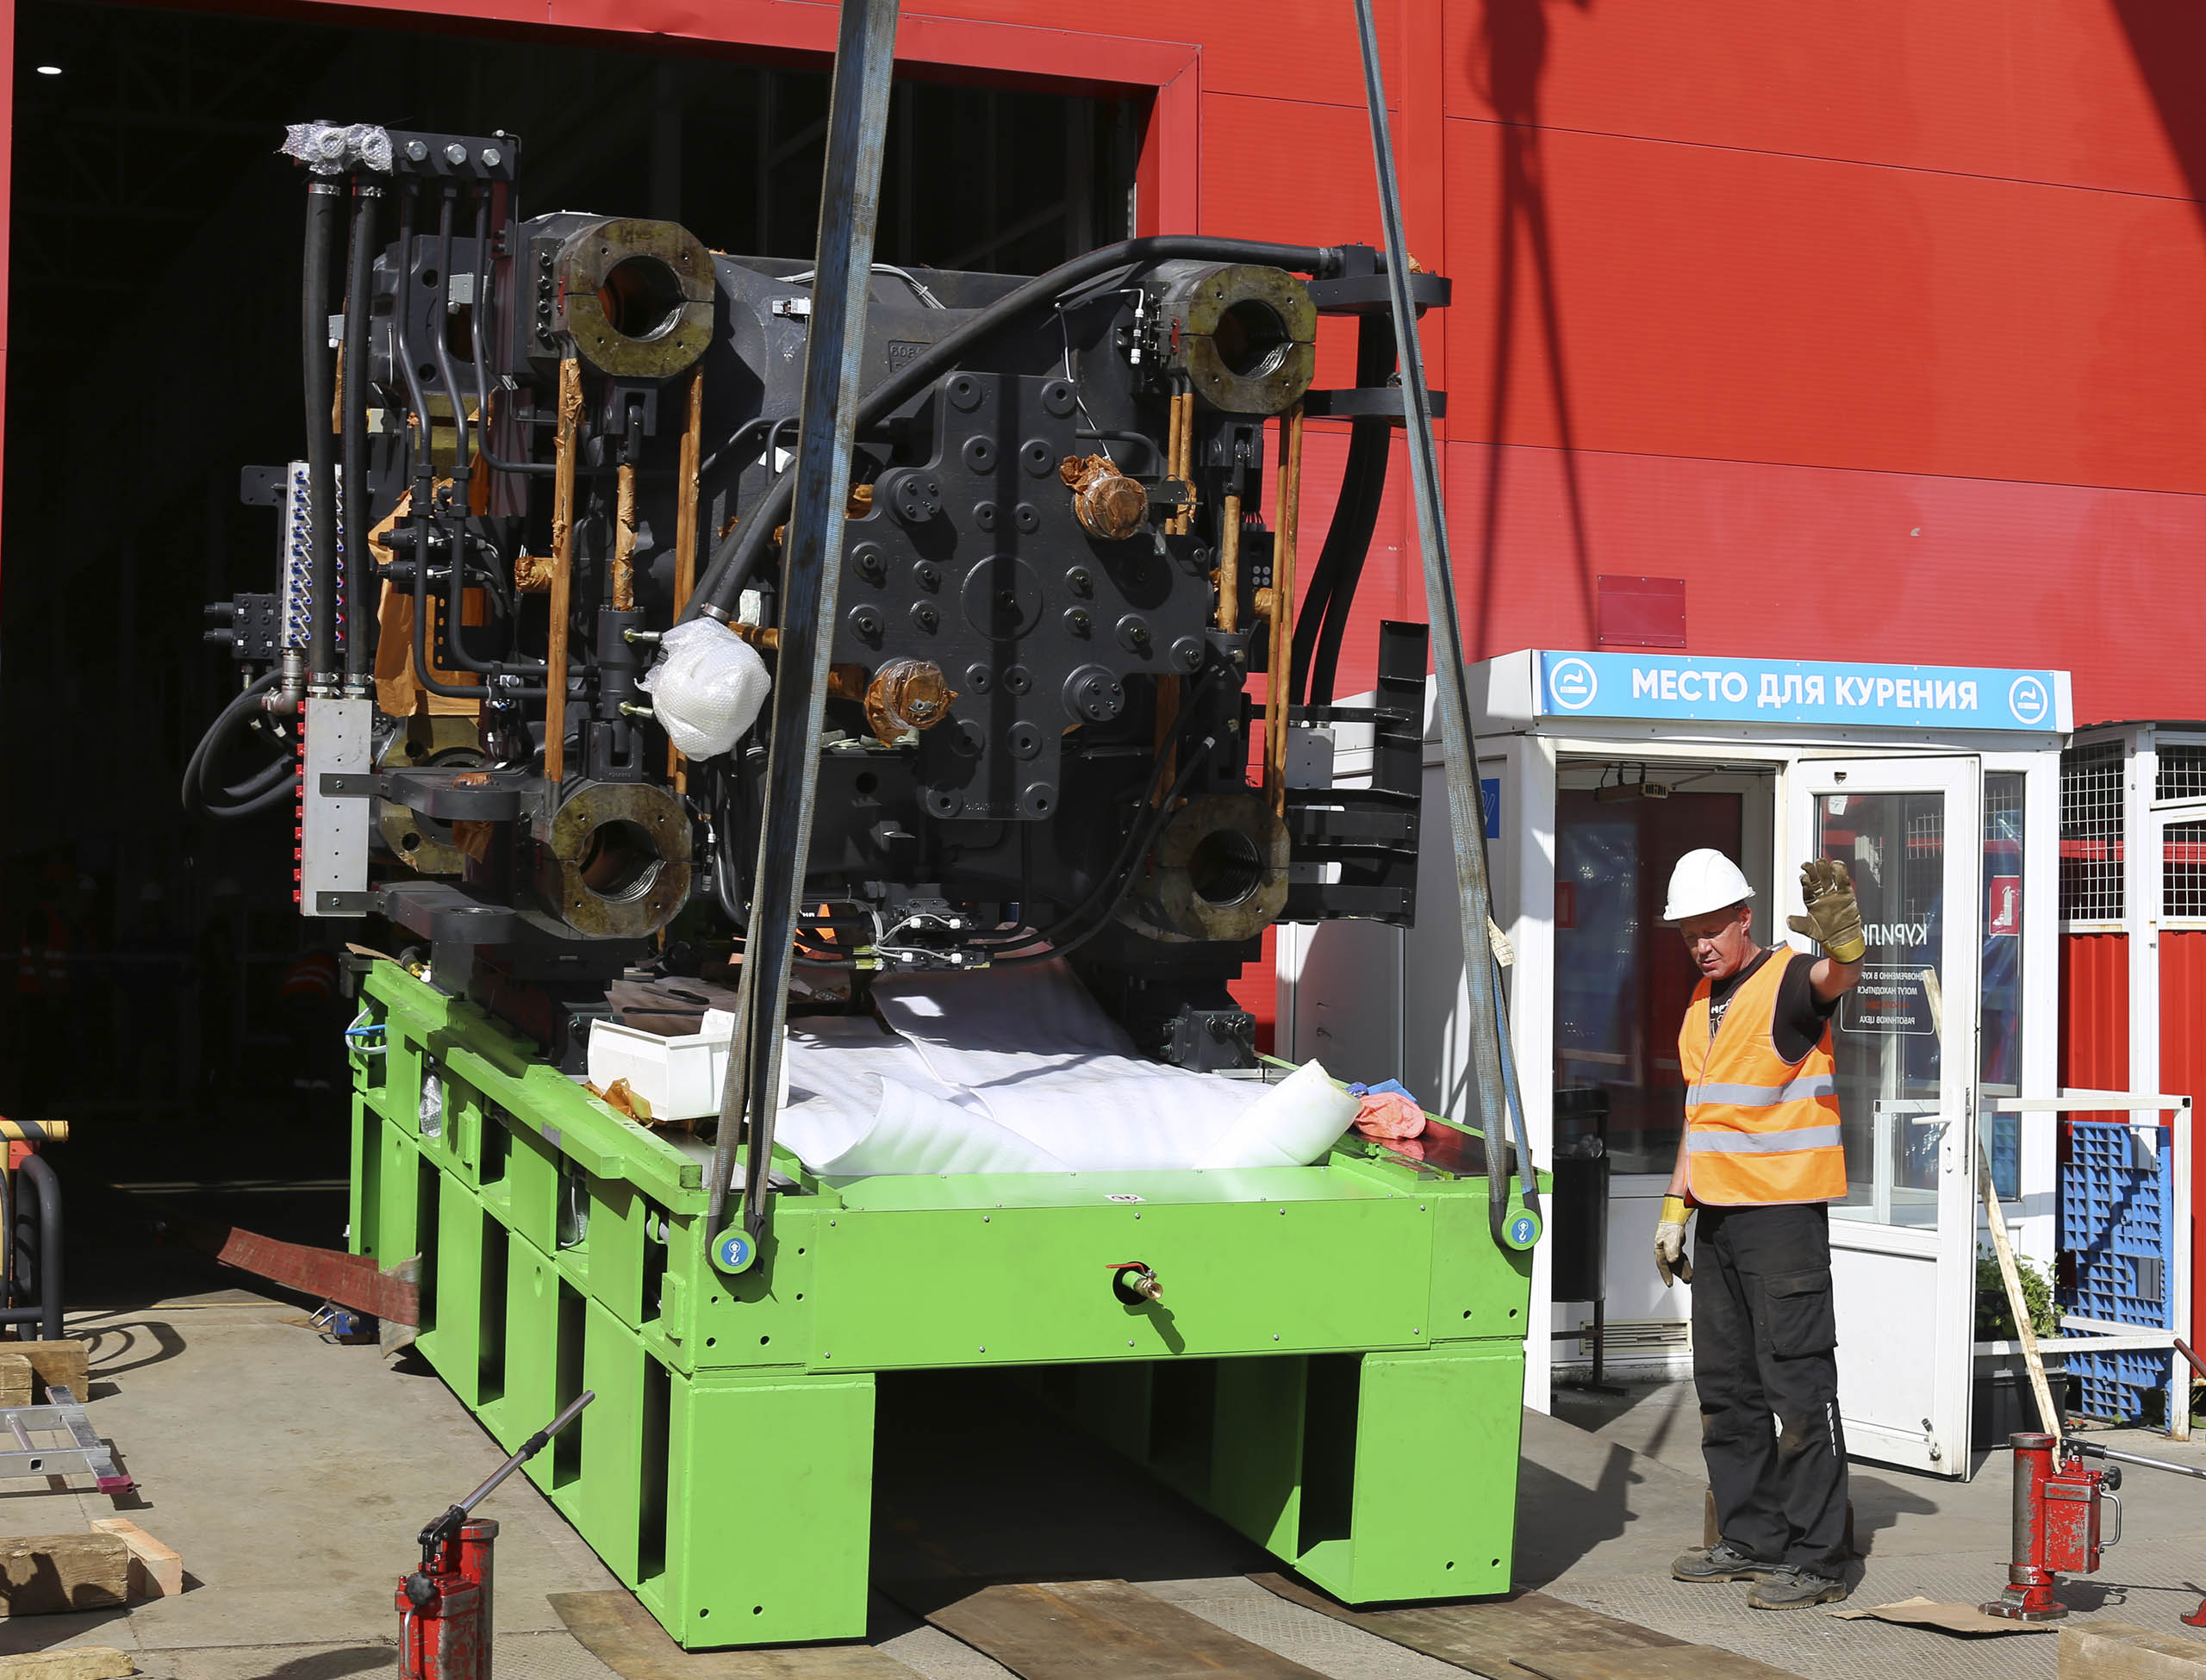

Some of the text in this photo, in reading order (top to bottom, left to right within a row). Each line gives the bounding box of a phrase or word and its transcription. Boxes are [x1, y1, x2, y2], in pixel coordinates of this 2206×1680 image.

[1632, 669, 1979, 710] МЕСТО ДЛЯ КУРЕНИЯ
